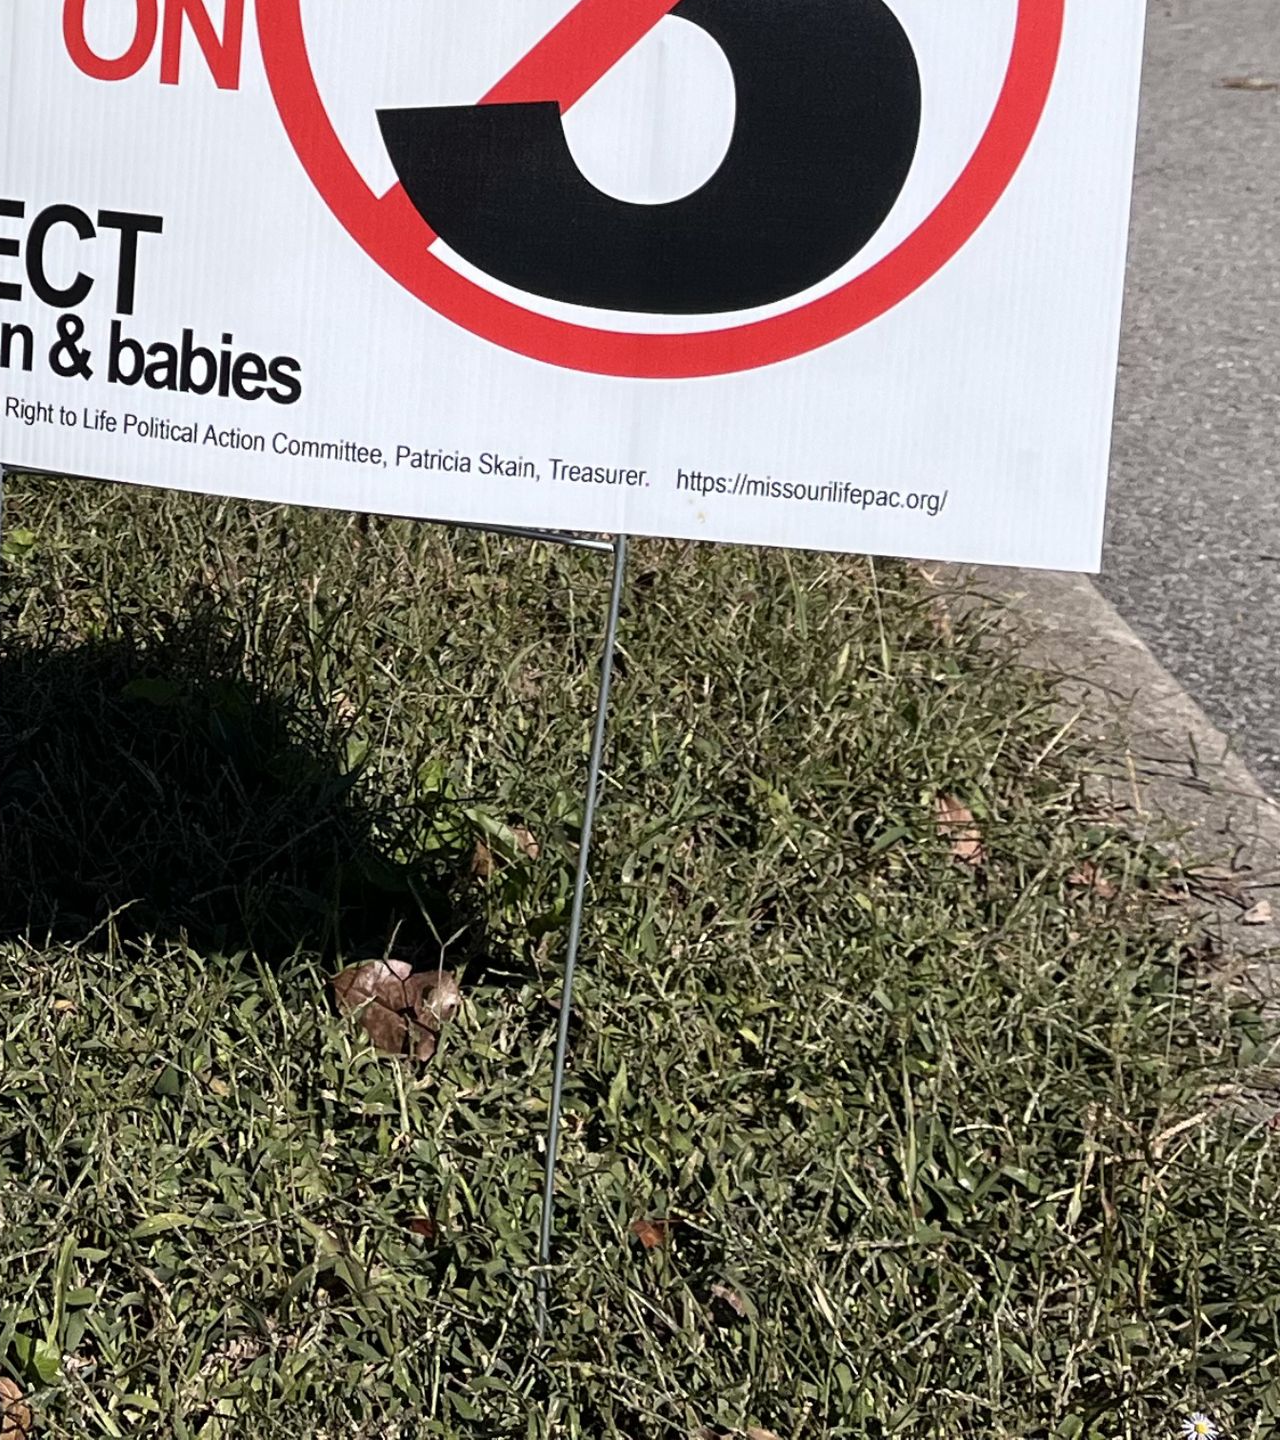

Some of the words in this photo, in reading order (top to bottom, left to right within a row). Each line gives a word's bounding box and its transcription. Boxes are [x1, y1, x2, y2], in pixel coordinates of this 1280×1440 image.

[48, 312, 94, 381] &
[107, 319, 303, 406] babies
[5, 396, 55, 427] Right
[59, 404, 78, 428] to
[83, 407, 118, 434] Life
[123, 413, 198, 444] Political
[202, 424, 265, 453] Action
[272, 431, 387, 469] Committee,
[395, 444, 471, 474] Patricia
[478, 452, 541, 483] Skain,
[548, 458, 650, 488] Treasurer.
[675, 468, 949, 517] https://missourilifepac.org/
